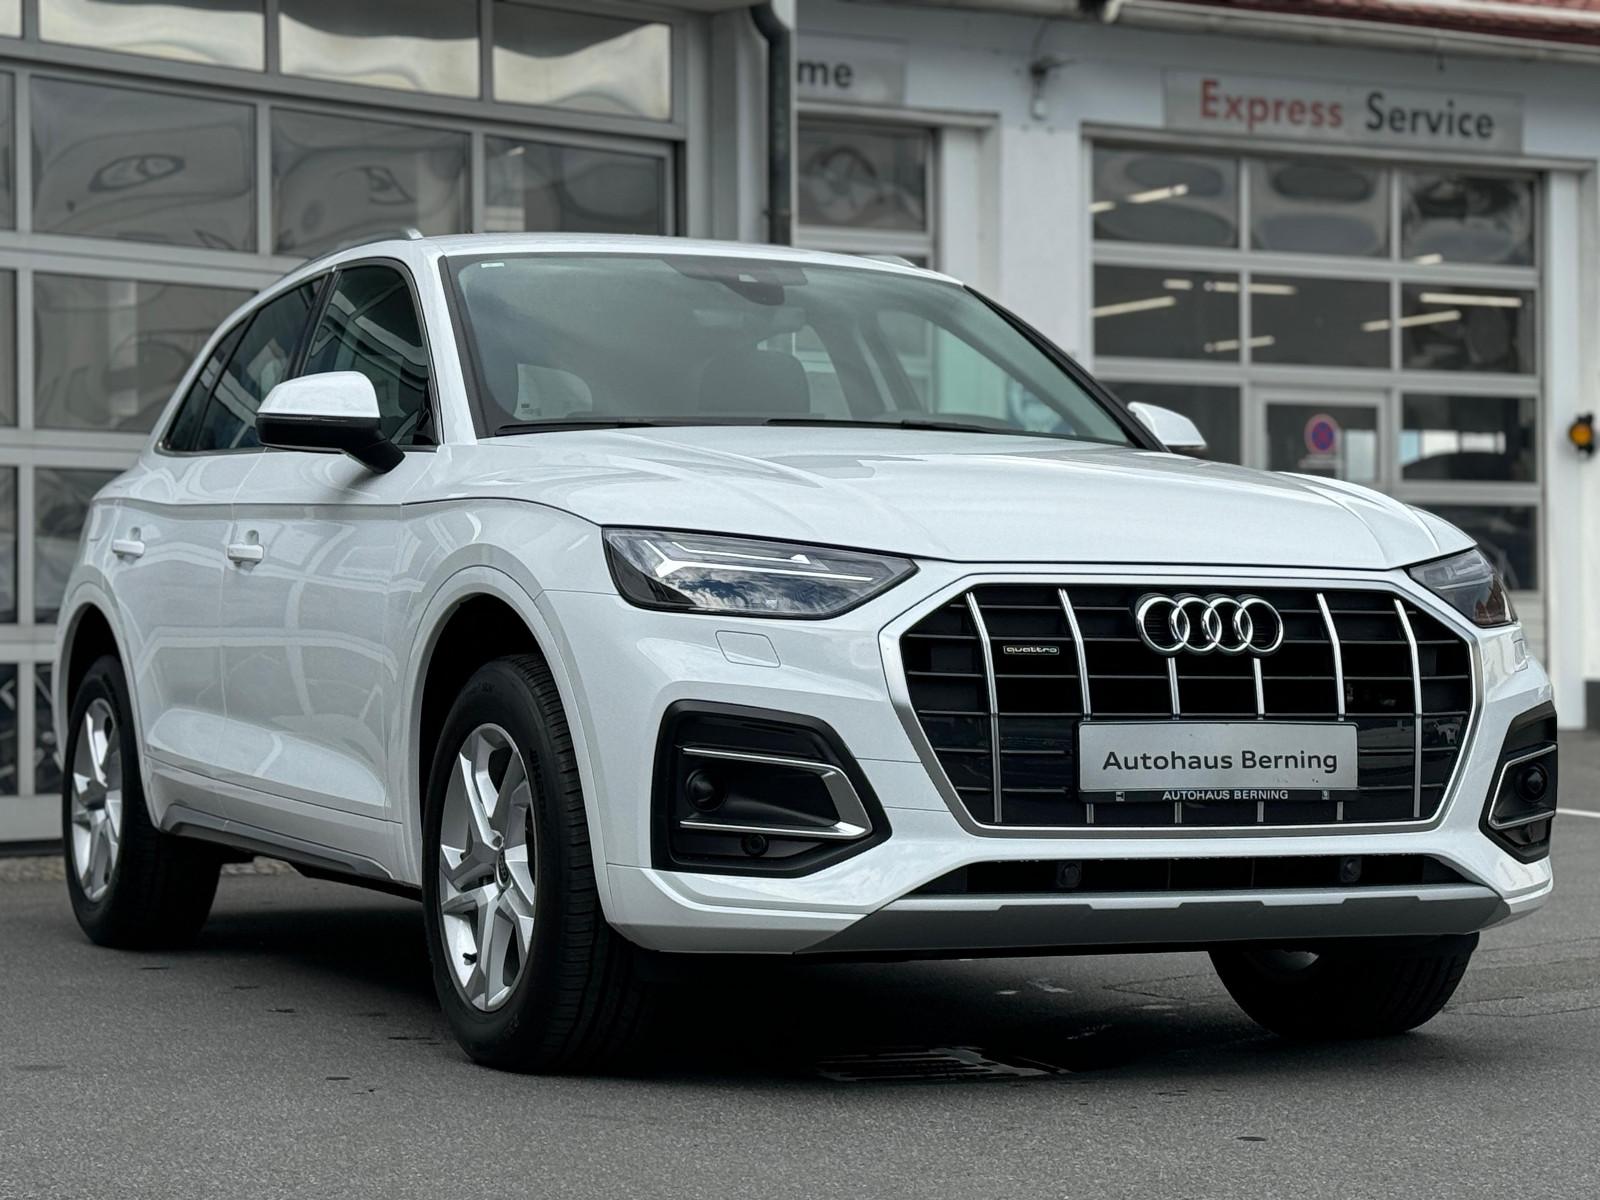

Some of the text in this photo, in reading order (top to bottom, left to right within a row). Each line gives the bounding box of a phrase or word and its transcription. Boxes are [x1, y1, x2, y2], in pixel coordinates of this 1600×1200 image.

[1200, 79, 1495, 139] Express Service
[1006, 646, 1058, 654] quattro
[1102, 750, 1337, 774] Autohaus Berning
[1162, 790, 1289, 801] AUTOHAUS BERNING
